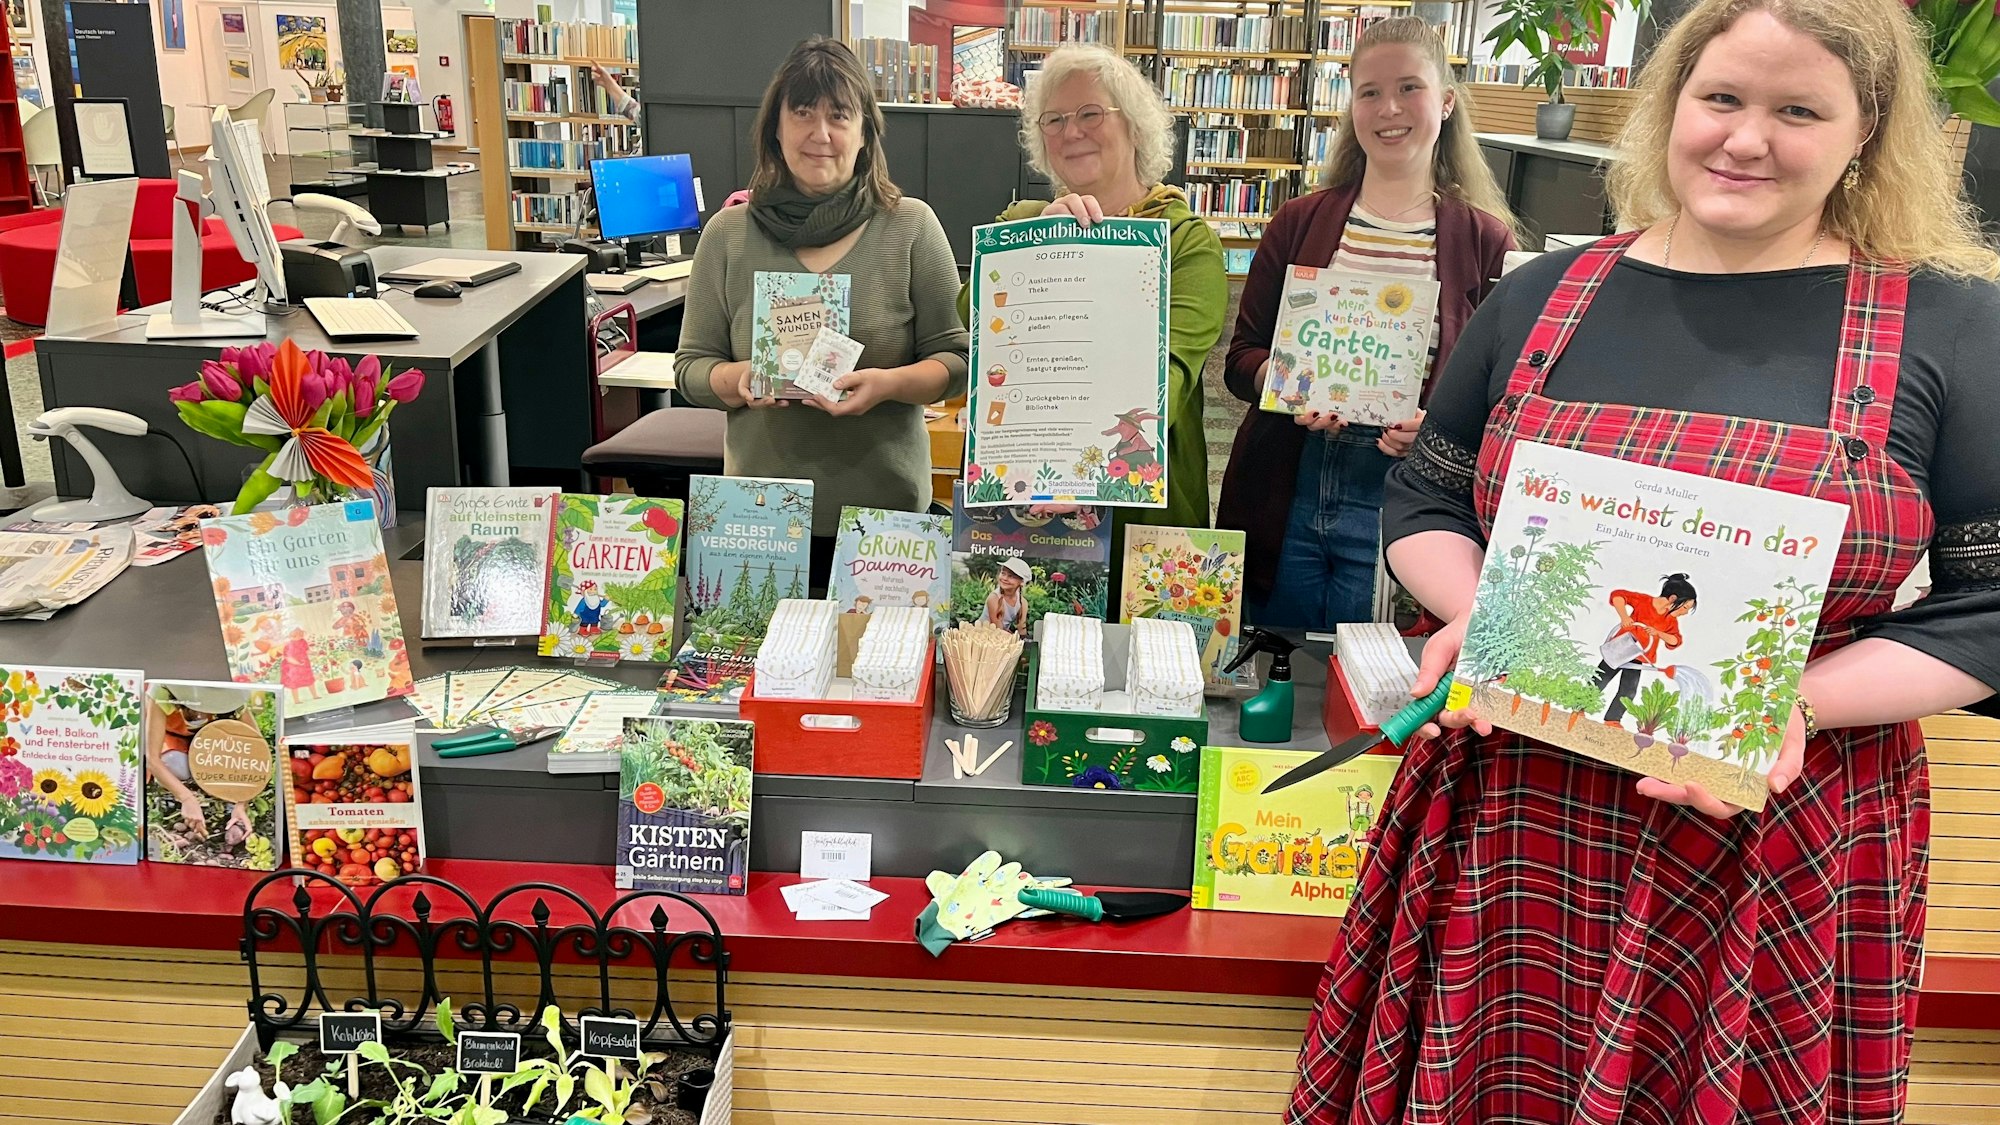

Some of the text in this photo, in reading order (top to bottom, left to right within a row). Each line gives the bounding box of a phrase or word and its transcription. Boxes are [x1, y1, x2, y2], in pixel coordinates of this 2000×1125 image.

[999, 222, 1137, 246] Saatgutbibliothek
[1036, 251, 1084, 260] SO GEHT'S
[1028, 276, 1062, 285] Ausleihen
[1028, 286, 1049, 294] Theke
[1337, 299, 1365, 312] Mein
[776, 310, 821, 325] SAMEN
[1028, 314, 1057, 322] Aussäen,
[1325, 310, 1407, 330] kunterbuntes
[778, 321, 822, 333] WUNDER
[1028, 324, 1051, 332] gießen
[1297, 318, 1403, 361] Garten-
[1026, 355, 1084, 364] Ernten, genießen,
[1026, 365, 1052, 373] Saatgut
[1317, 353, 1379, 387] Buch
[1048, 480, 1095, 488] Stadtbibliothek
[1048, 487, 1095, 495] Leverkusen
[1634, 479, 1699, 502] Gerda Muller
[453, 493, 530, 514] Große Ernte
[449, 512, 542, 522] auf kleinstem
[1524, 474, 1819, 560] Was wächst denn da?
[471, 523, 519, 535] Raum
[724, 523, 776, 538] SELBST
[283, 530, 347, 552] Garten
[700, 535, 798, 553] VERSORGUNG
[971, 530, 992, 541] Das
[1030, 534, 1095, 548] Gartenbuch
[1594, 522, 1711, 558] Ein Jahr in Opas Garten
[858, 534, 938, 562] GRÜNER
[970, 544, 1024, 557] für Kinder
[286, 552, 320, 570] uns
[573, 541, 653, 572] GARTEN
[739, 551, 763, 560] eigenen
[844, 559, 939, 580] Daumen
[711, 646, 733, 654] Die
[36, 726, 98, 739] Beet, Balkon
[25, 738, 110, 751] und Fensterbrett
[193, 737, 252, 754] GEMÜSE
[22, 751, 57, 760] Entdecke
[75, 754, 114, 763] Gärtnern
[195, 751, 271, 773] GÄRTNERN
[228, 773, 266, 783] EINFACH
[328, 807, 384, 816] Tomaten
[366, 818, 406, 827] genießen
[1255, 810, 1302, 828] Mein
[629, 824, 728, 849] KISTEN
[628, 847, 724, 872] Gärtnern
[648, 875, 691, 884] Selbstversorgung
[1291, 881, 1354, 902] AlphaB
[331, 1024, 376, 1043] Kohlrabi
[589, 1030, 637, 1049] Kopfsalat
[464, 1039, 515, 1050] Blumenkohl
[463, 1057, 503, 1069] Brokkoli
